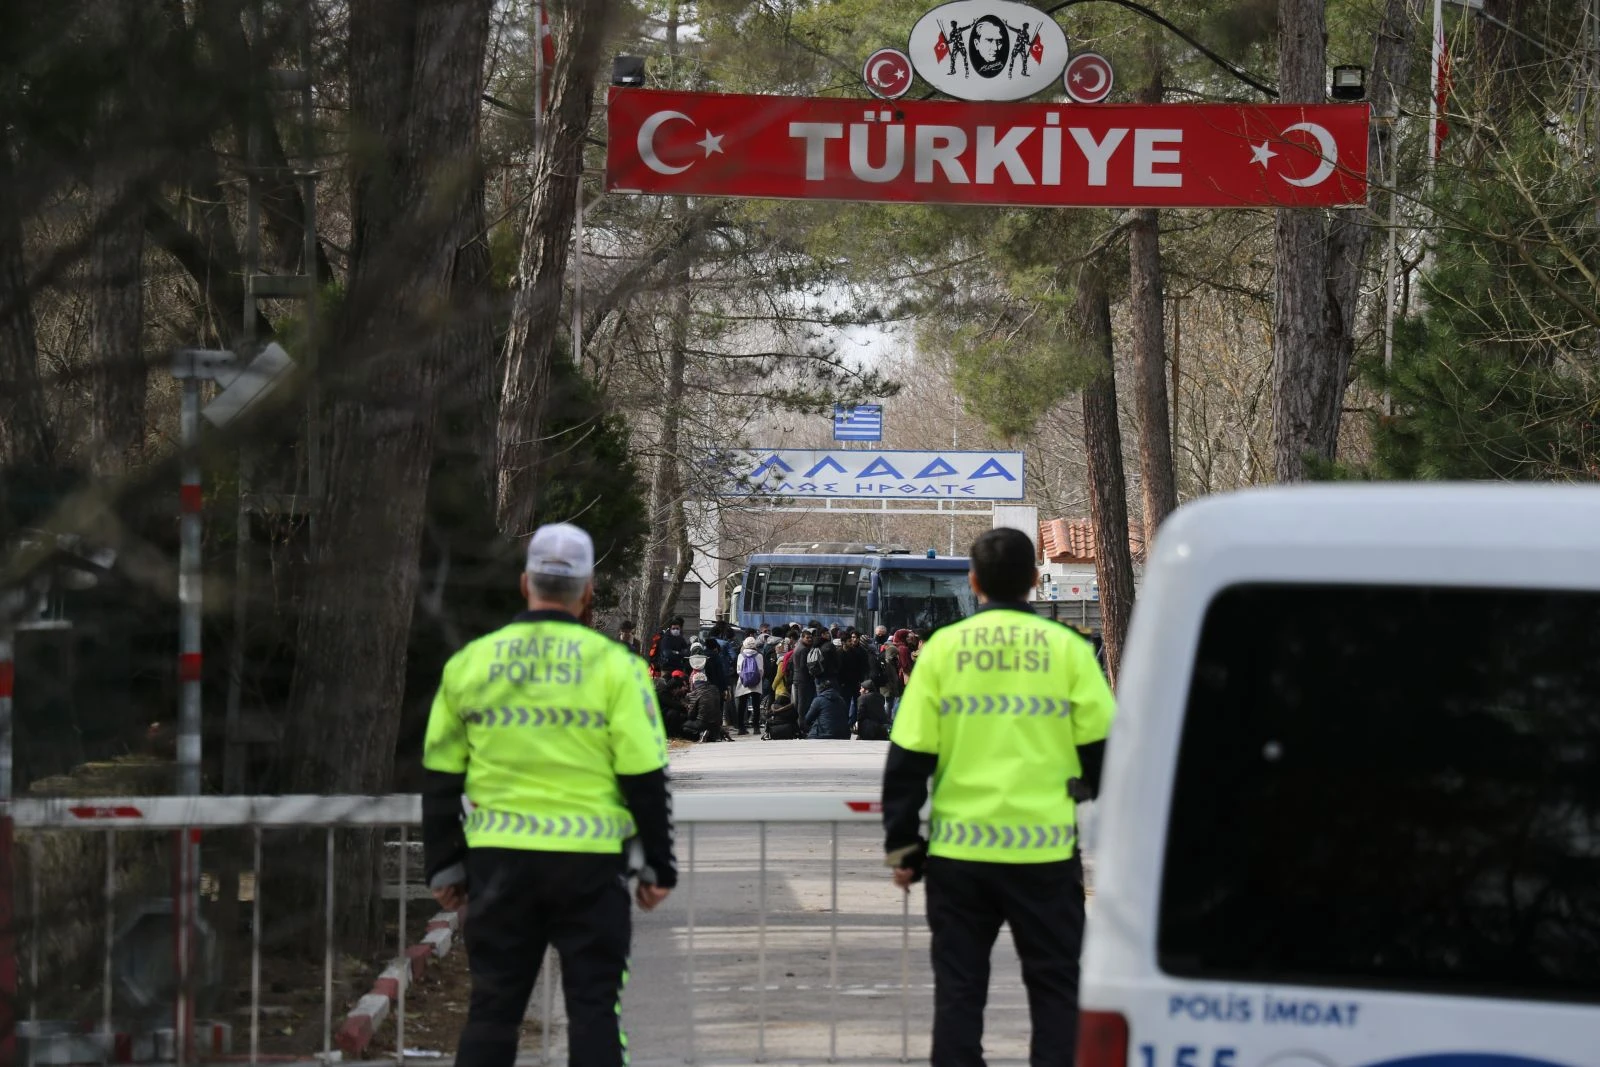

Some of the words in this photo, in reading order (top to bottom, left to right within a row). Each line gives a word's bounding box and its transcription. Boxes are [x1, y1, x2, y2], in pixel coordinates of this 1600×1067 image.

[788, 110, 1183, 189] TÜRKİYE
[701, 452, 1016, 481] ΛΛΑΔΑ
[856, 483, 975, 495] ΗΡΘΑΤΕ
